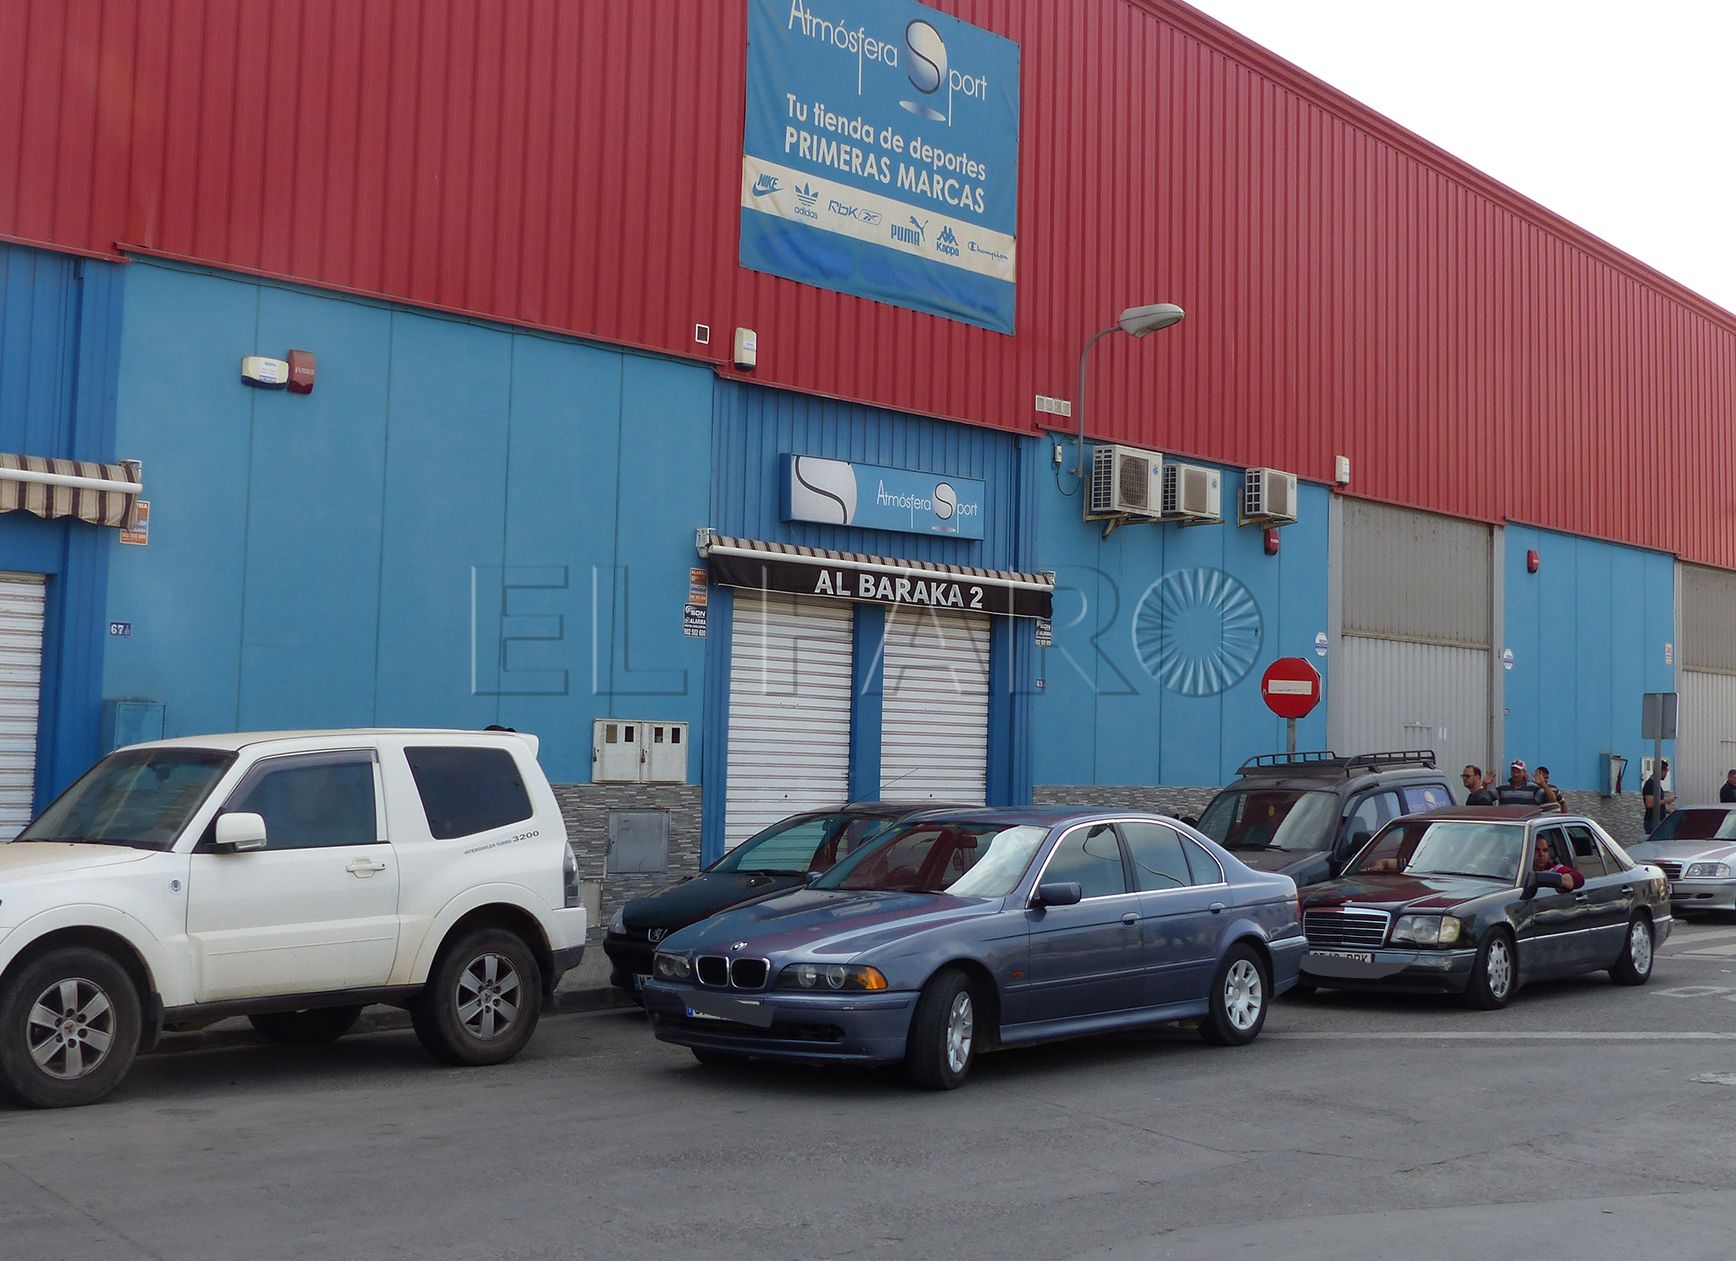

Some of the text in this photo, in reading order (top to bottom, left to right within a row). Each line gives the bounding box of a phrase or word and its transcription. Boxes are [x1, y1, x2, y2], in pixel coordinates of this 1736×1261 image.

[788, 0, 898, 96] Atmósfera
[786, 93, 986, 181] Tu tienda de deportes
[785, 126, 985, 213] PRIMERAS MARCAS
[757, 173, 779, 189] NIKE
[794, 206, 819, 220] adidas
[890, 223, 920, 247] PUMA
[936, 241, 960, 257] Kappa
[967, 241, 1009, 261] Champion
[876, 479, 932, 529] Atmósfera
[814, 569, 984, 609] AL BARAKA 2
[111, 624, 124, 635] 67
[512, 830, 540, 843] 3200
